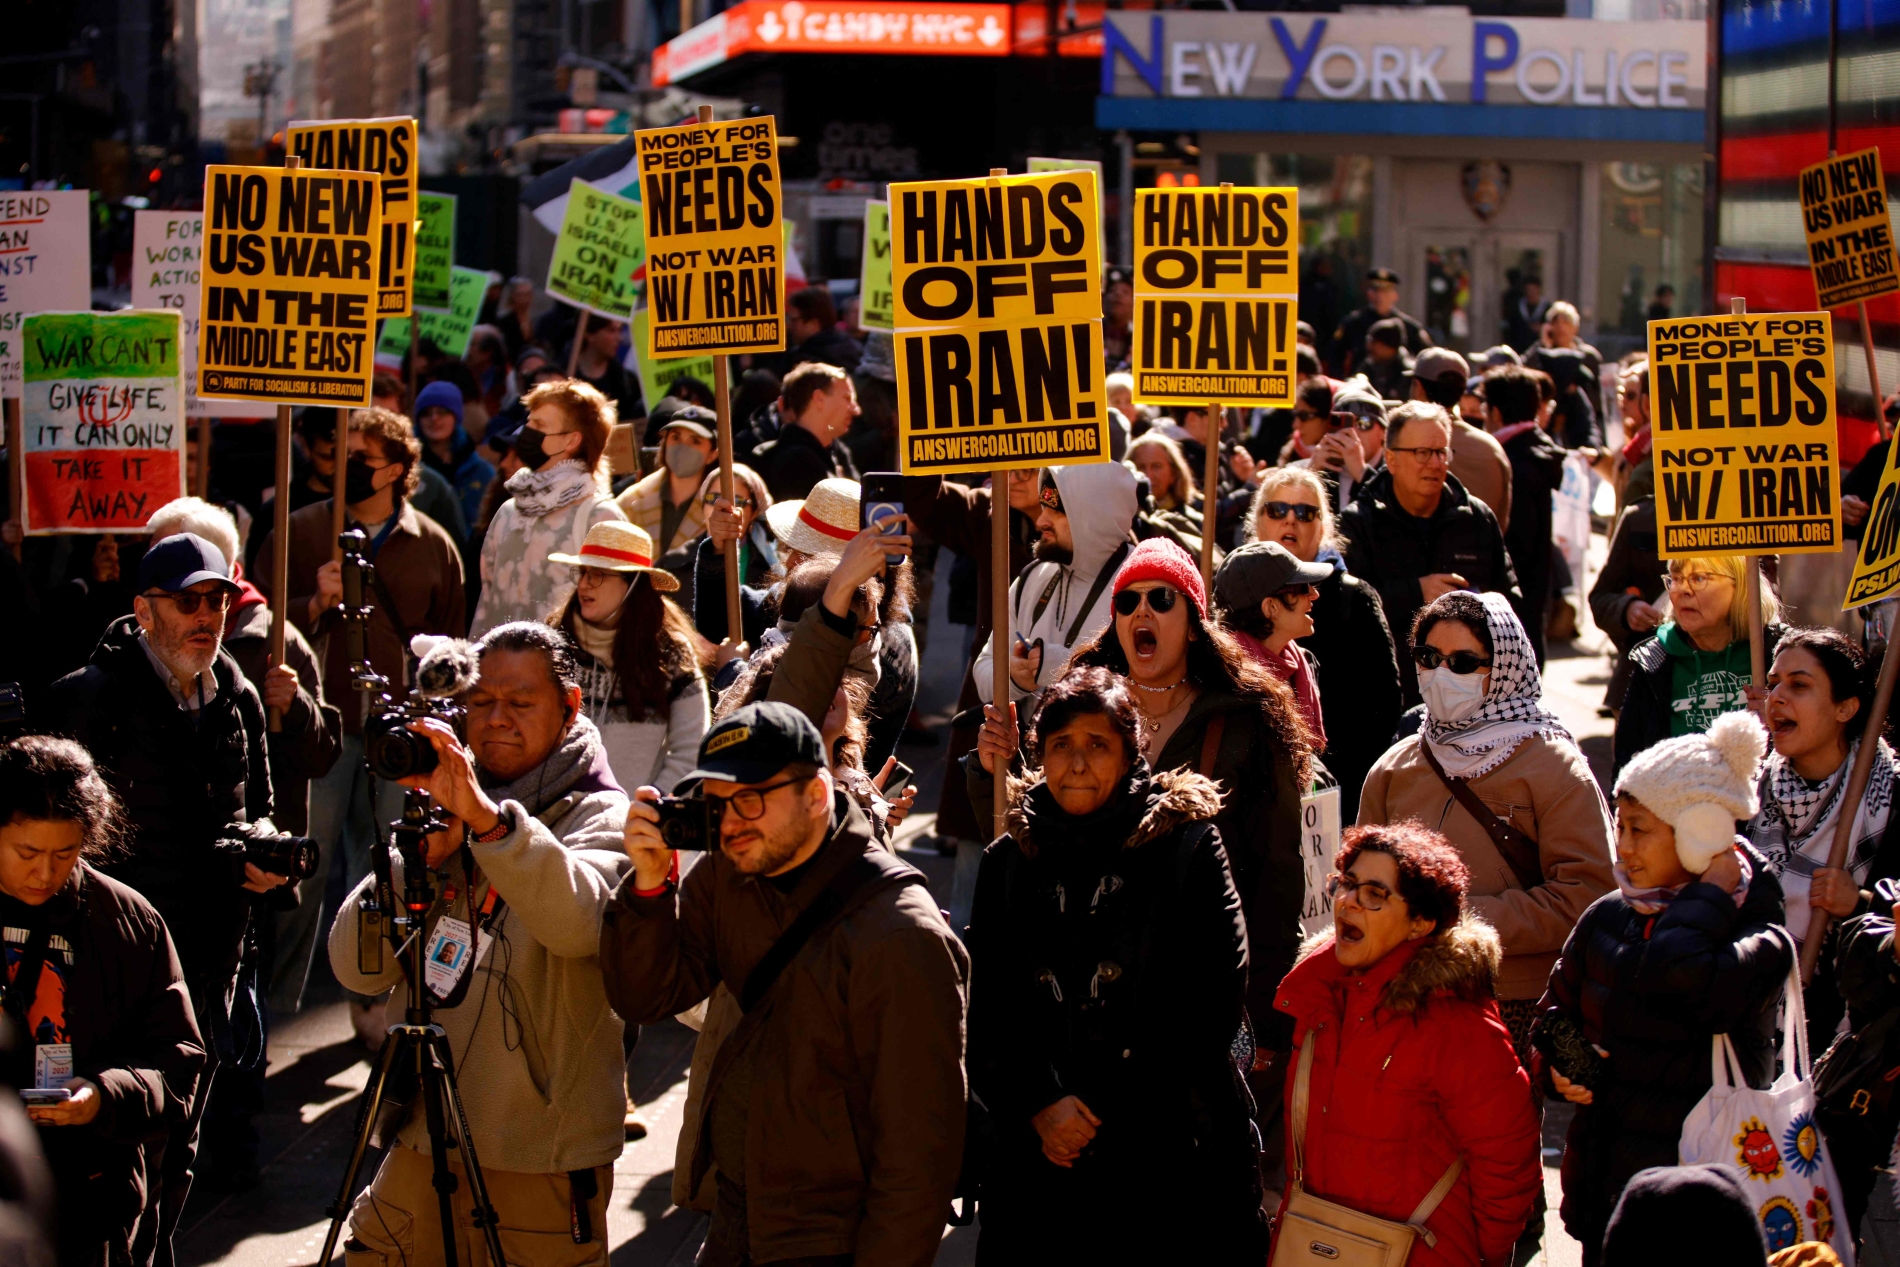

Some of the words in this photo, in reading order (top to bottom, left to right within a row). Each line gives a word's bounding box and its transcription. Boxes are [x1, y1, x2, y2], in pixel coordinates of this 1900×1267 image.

[1102, 16, 1257, 97] NEW
[1270, 18, 1447, 101] YORK
[1471, 21, 1689, 107] POLICE
[294, 124, 410, 175] HANDS
[641, 128, 718, 151] MONEY
[726, 123, 770, 142] FOR
[643, 141, 772, 171] PEOPLE'S
[644, 162, 775, 237] NEEDS
[1802, 168, 1827, 207] NO
[1828, 152, 1878, 198] NEW
[212, 173, 268, 231] NO
[278, 176, 374, 236] NEW
[585, 195, 637, 221] STOP
[902, 181, 1085, 263] HANDS
[1144, 193, 1288, 247] HANDS
[1804, 204, 1832, 233] US
[1831, 190, 1885, 225] WAR
[209, 233, 266, 276] US
[270, 238, 372, 281] WAR
[567, 223, 639, 259] ISRAELI
[577, 246, 617, 274] ON
[650, 250, 701, 271] NOT
[707, 244, 775, 266] WAR
[1810, 237, 1836, 264] IN
[1836, 223, 1890, 255] THE
[560, 261, 625, 298] IRAN
[1142, 249, 1288, 289] OFF
[1815, 256, 1860, 291] MIDDLE
[1861, 248, 1894, 279] EAST
[207, 287, 260, 324] IN
[265, 289, 369, 329] THE
[652, 272, 694, 323] W/
[704, 267, 777, 320] IRAN
[902, 259, 1088, 320] OFF
[205, 325, 298, 370] MIDDLE
[304, 331, 366, 373] EAST
[657, 322, 777, 347] ANSWERCOALITION.ORG
[1142, 300, 1288, 371] IRAN!
[1655, 322, 1759, 341] MONEY
[1765, 319, 1824, 336] FOR
[1655, 338, 1826, 362] PEOPLE'S
[36, 334, 96, 370] WAR
[49, 382, 101, 410] GIVE
[224, 377, 247, 390] PARTY
[250, 378, 264, 391] FOR
[265, 379, 308, 394] SOCIALISM
[318, 383, 364, 397] LIBERATION
[905, 323, 1096, 431] IRAN!
[1142, 375, 1286, 395] ANSWERCOALITION.ORG
[1657, 359, 1827, 431] NEEDS
[37, 425, 62, 446] IT
[75, 423, 118, 448] CAN
[123, 424, 174, 449] ONLY
[913, 429, 1096, 462] ANSWERCOALITION.ORG
[1661, 447, 1736, 467] NOT
[1744, 443, 1829, 462] WAR
[52, 458, 112, 481] TAKE
[122, 457, 149, 481] IT
[1663, 470, 1723, 522] W/
[1739, 466, 1831, 518] IRAN
[1668, 522, 1831, 548] ANSWERCOALITION.ORG
